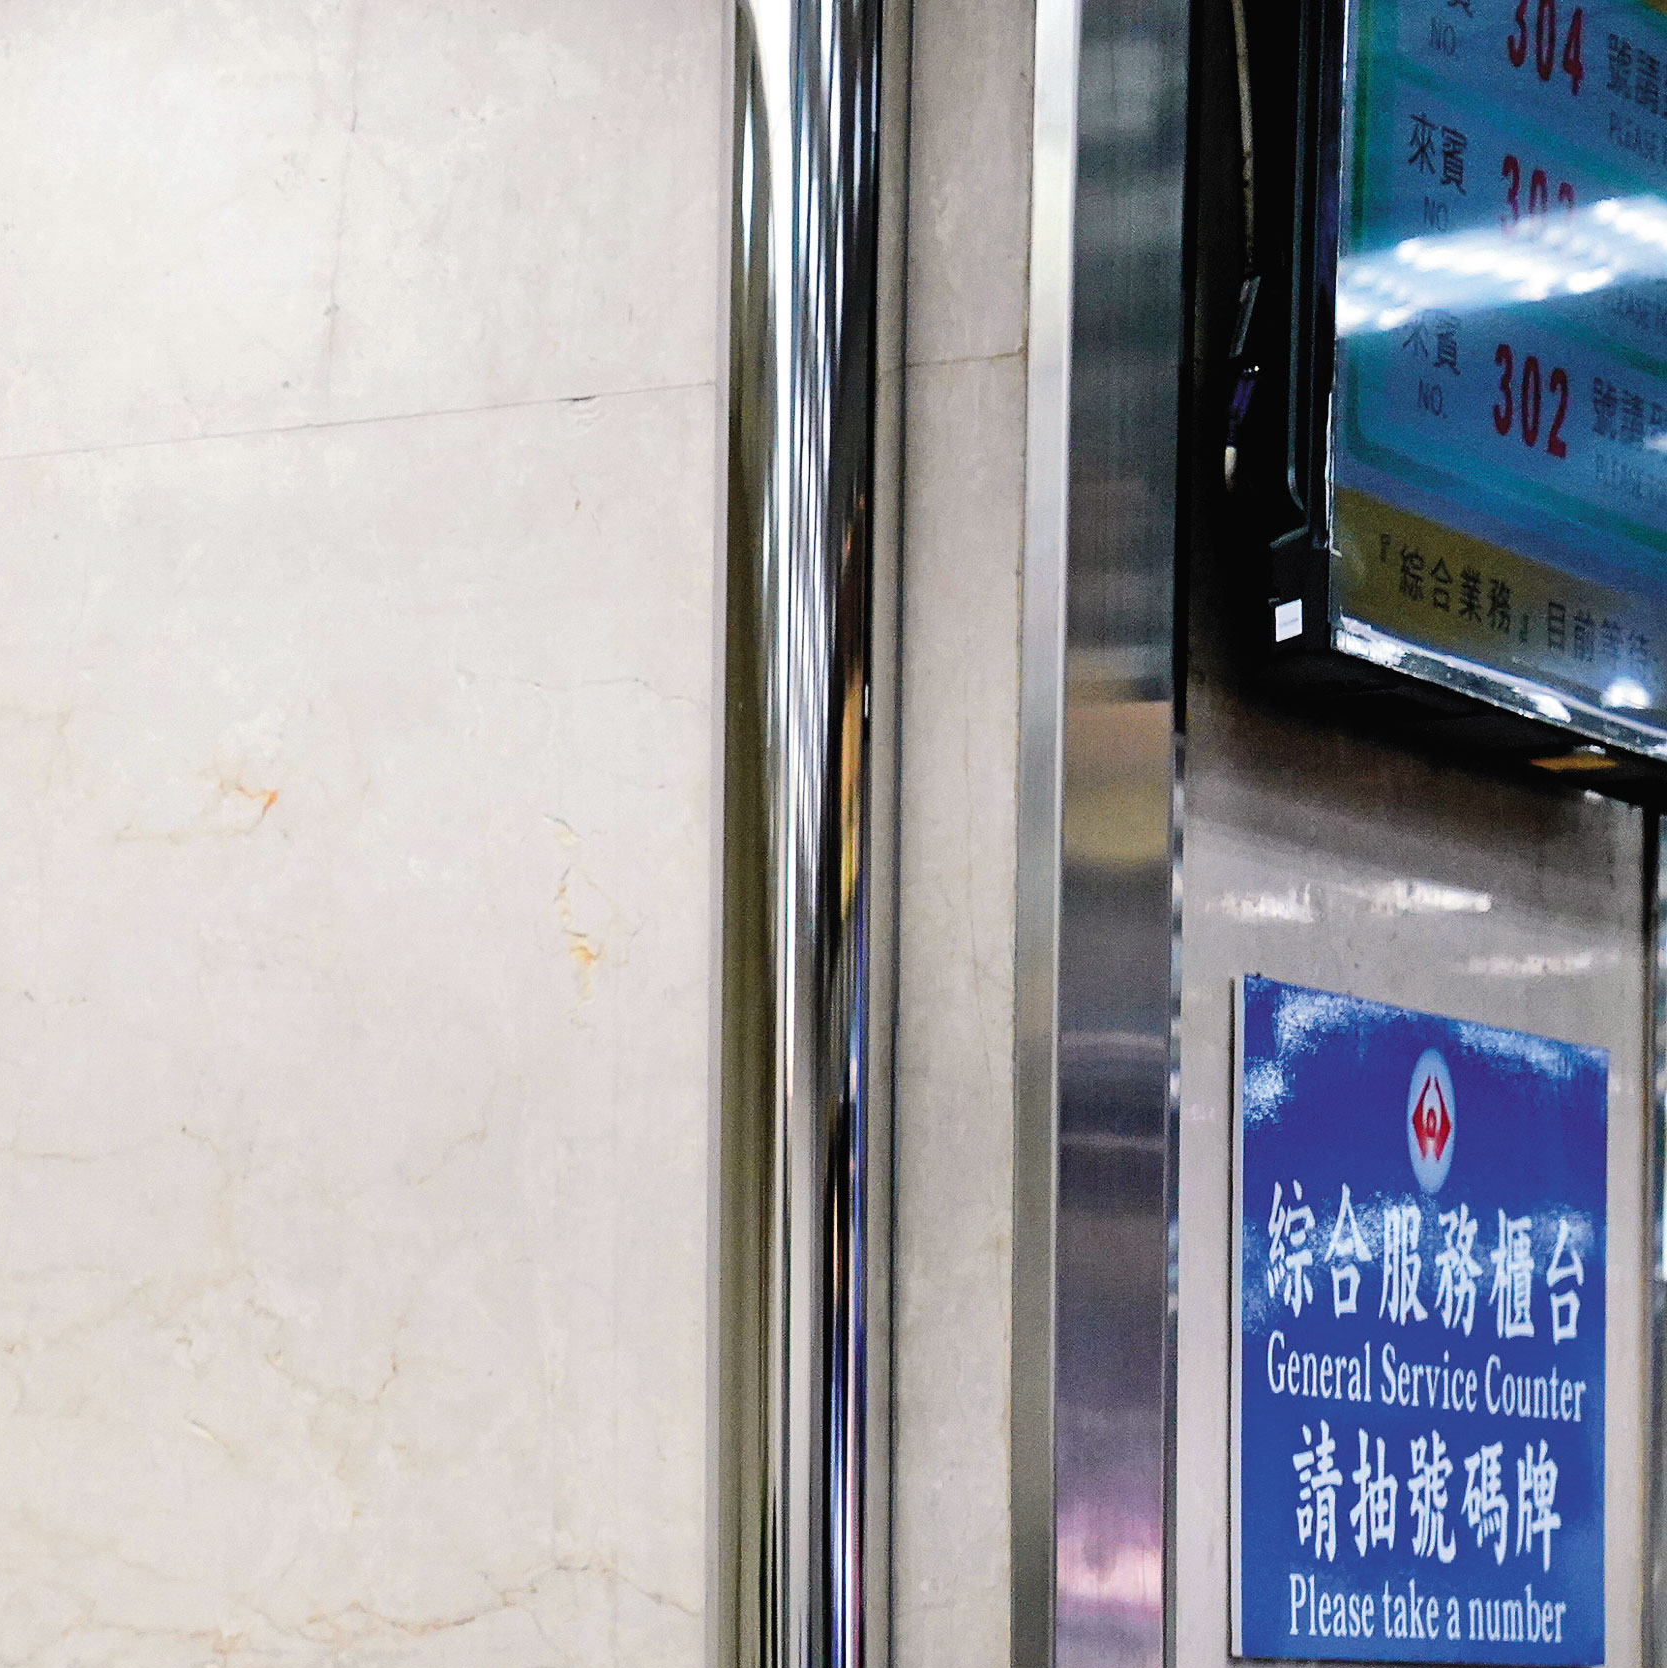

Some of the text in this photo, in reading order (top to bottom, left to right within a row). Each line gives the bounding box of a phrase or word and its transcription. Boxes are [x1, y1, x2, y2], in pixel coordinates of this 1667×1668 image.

[1507, 0, 1583, 97] 304
[1407, 111, 1467, 196] 來賓
[1493, 343, 1568, 460] 302
[1267, 1178, 1585, 1345] 綜合服務櫃台
[1267, 1330, 1586, 1423] General Service Counter
[1292, 1418, 1561, 1572] 請抽號碼牌
[1288, 1571, 1566, 1645] Please take a number
